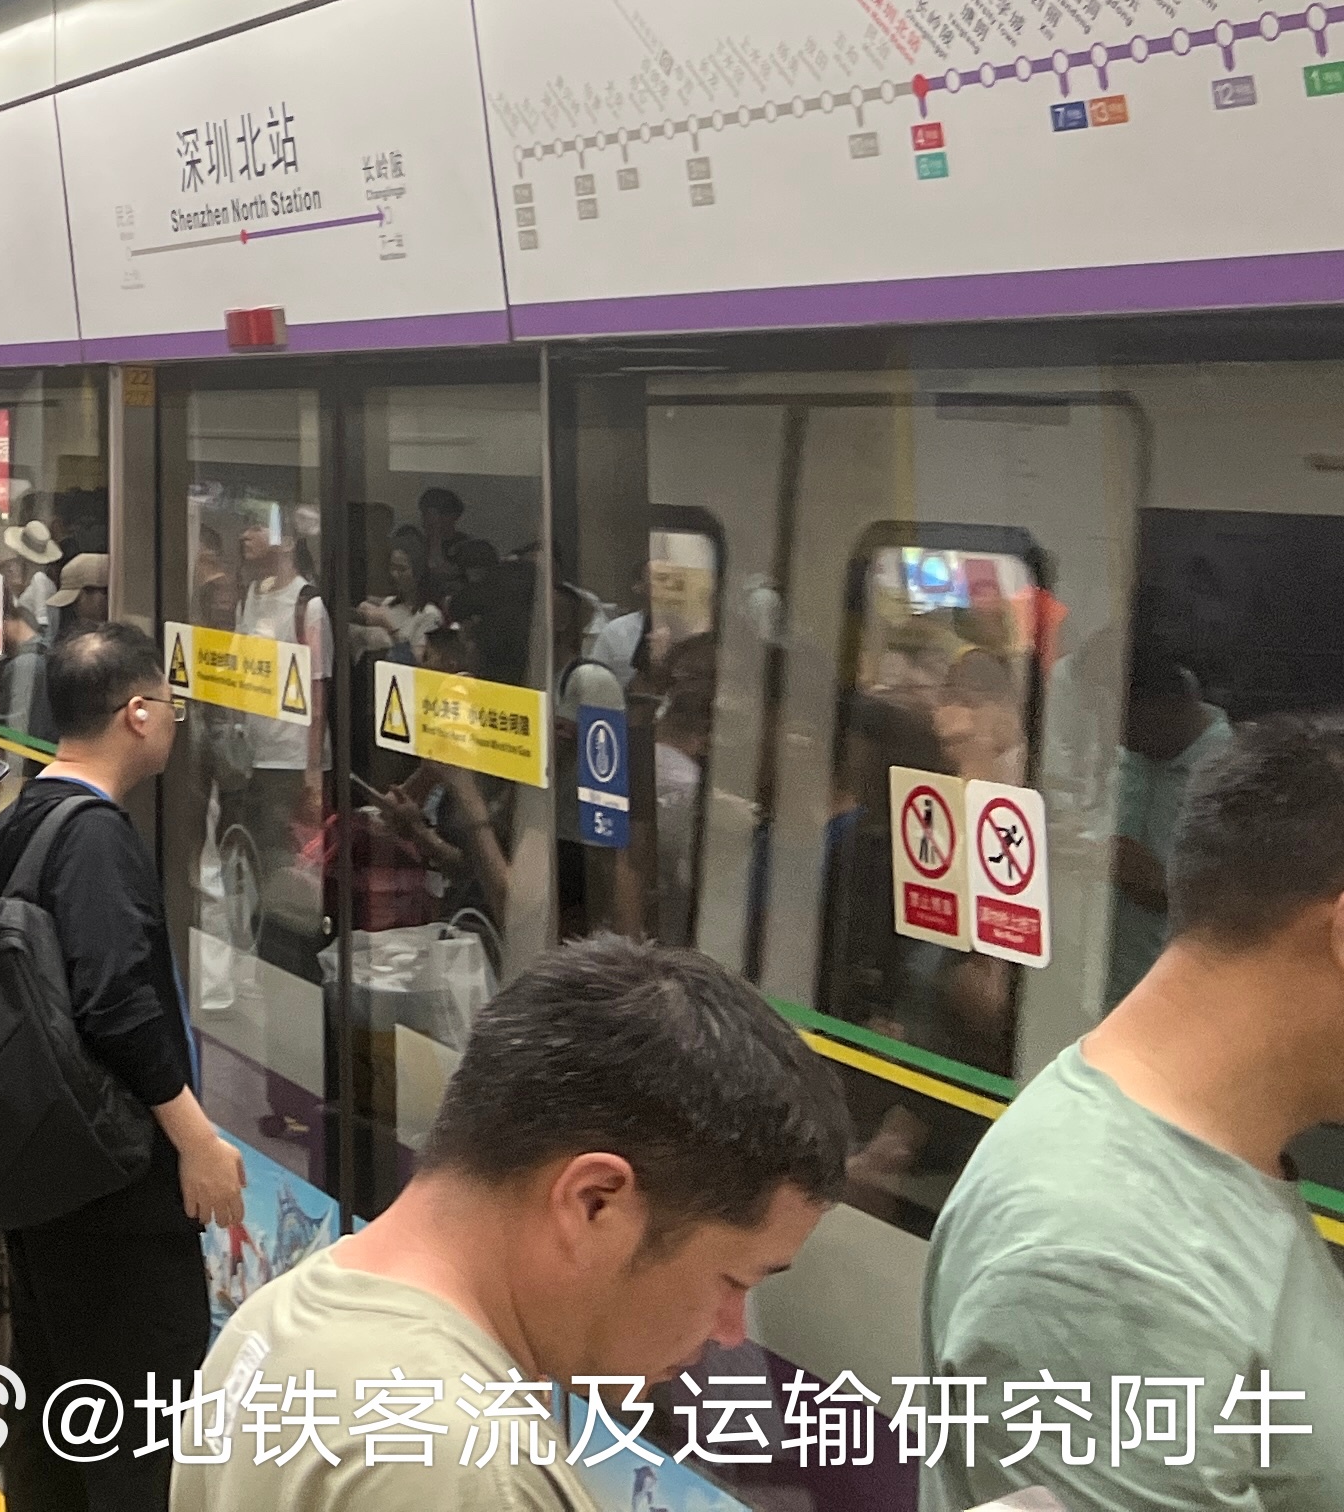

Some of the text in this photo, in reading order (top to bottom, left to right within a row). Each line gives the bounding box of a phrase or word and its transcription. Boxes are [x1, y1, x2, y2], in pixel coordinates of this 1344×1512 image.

[177, 101, 299, 192] 深圳北站
[170, 187, 322, 233] Shenzhen North Station
